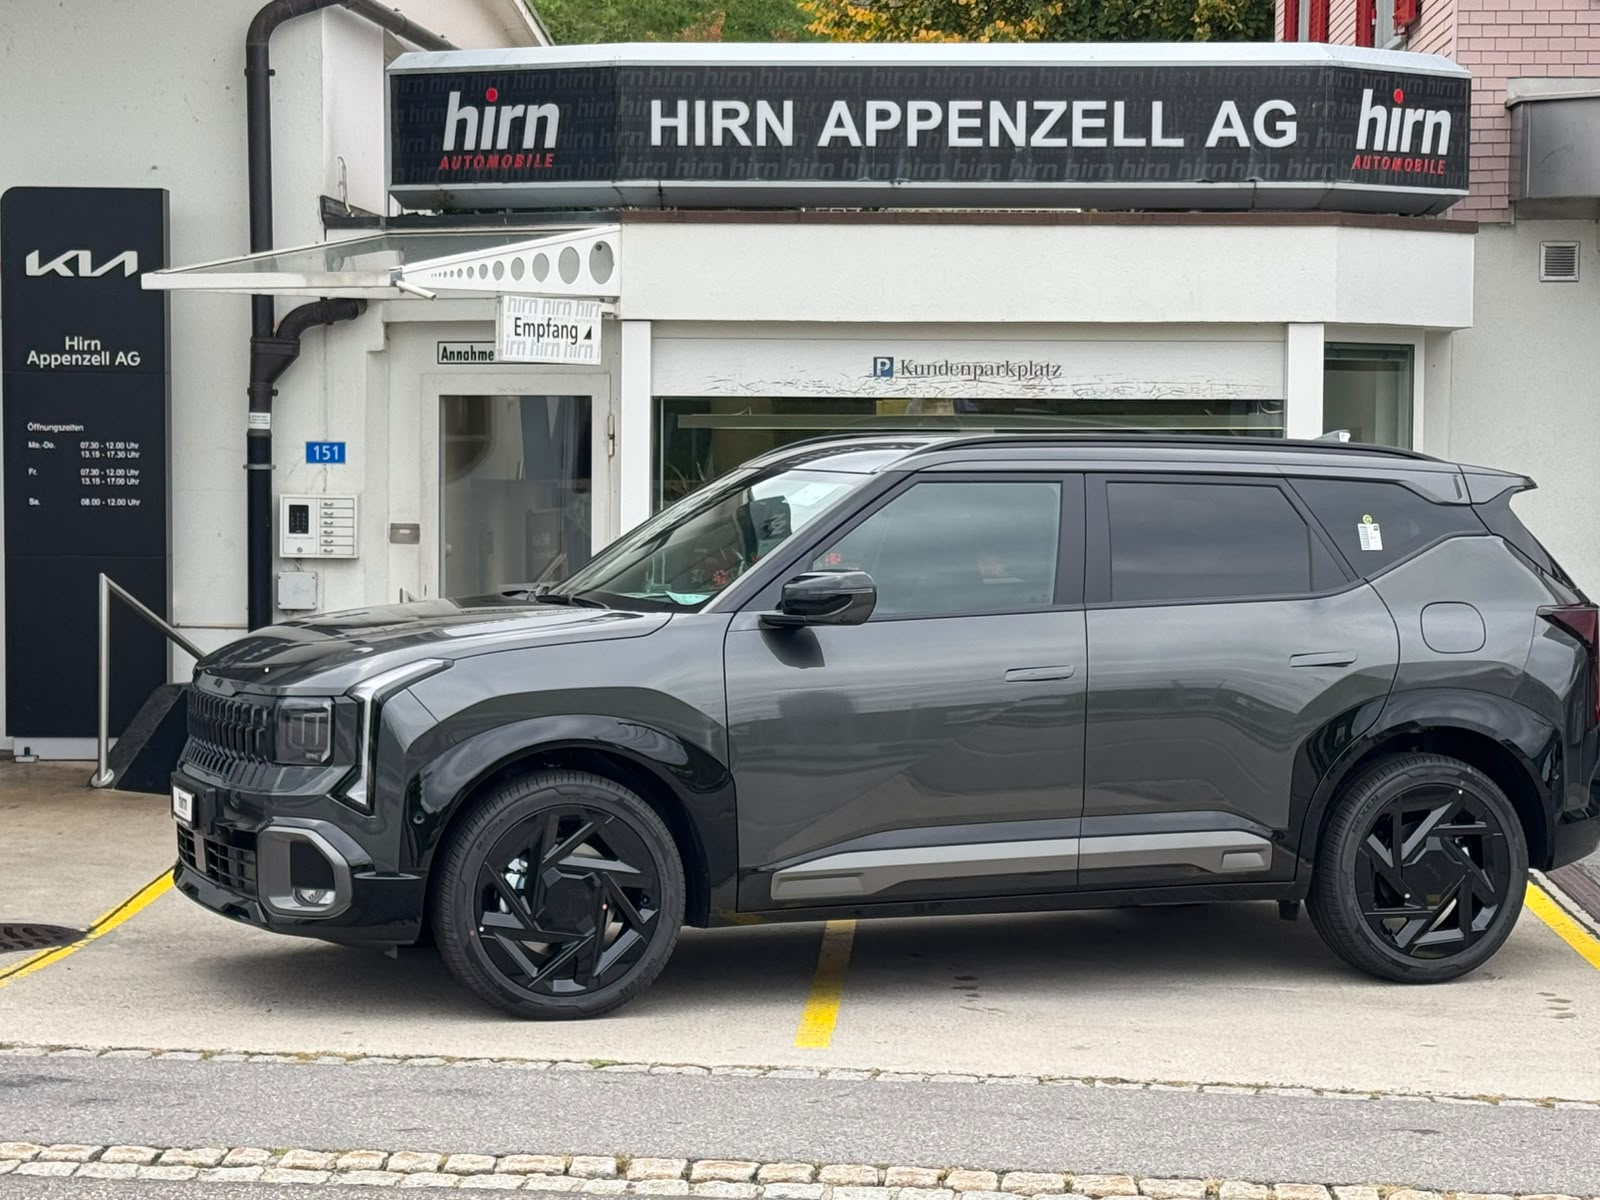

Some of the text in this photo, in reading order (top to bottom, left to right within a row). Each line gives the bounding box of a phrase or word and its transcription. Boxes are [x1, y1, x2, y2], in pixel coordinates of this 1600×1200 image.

[442, 88, 561, 151] hirn
[650, 99, 1297, 148] HIRN APPENZELL AG
[1355, 88, 1451, 155] hirn
[439, 153, 554, 170] AUTOMOBILE
[1352, 154, 1446, 175] AUTOMOBILE
[514, 317, 578, 345] Empfang
[65, 336, 101, 350] Hirn
[27, 351, 141, 368] Appenzell AG
[441, 345, 494, 361] Annahme
[901, 360, 1062, 380] Kundenparkplatz
[27, 422, 84, 433] Öffnungszeiten
[314, 445, 339, 461] 151
[107, 498, 126, 506] 12.00
[127, 498, 141, 506] Uhr
